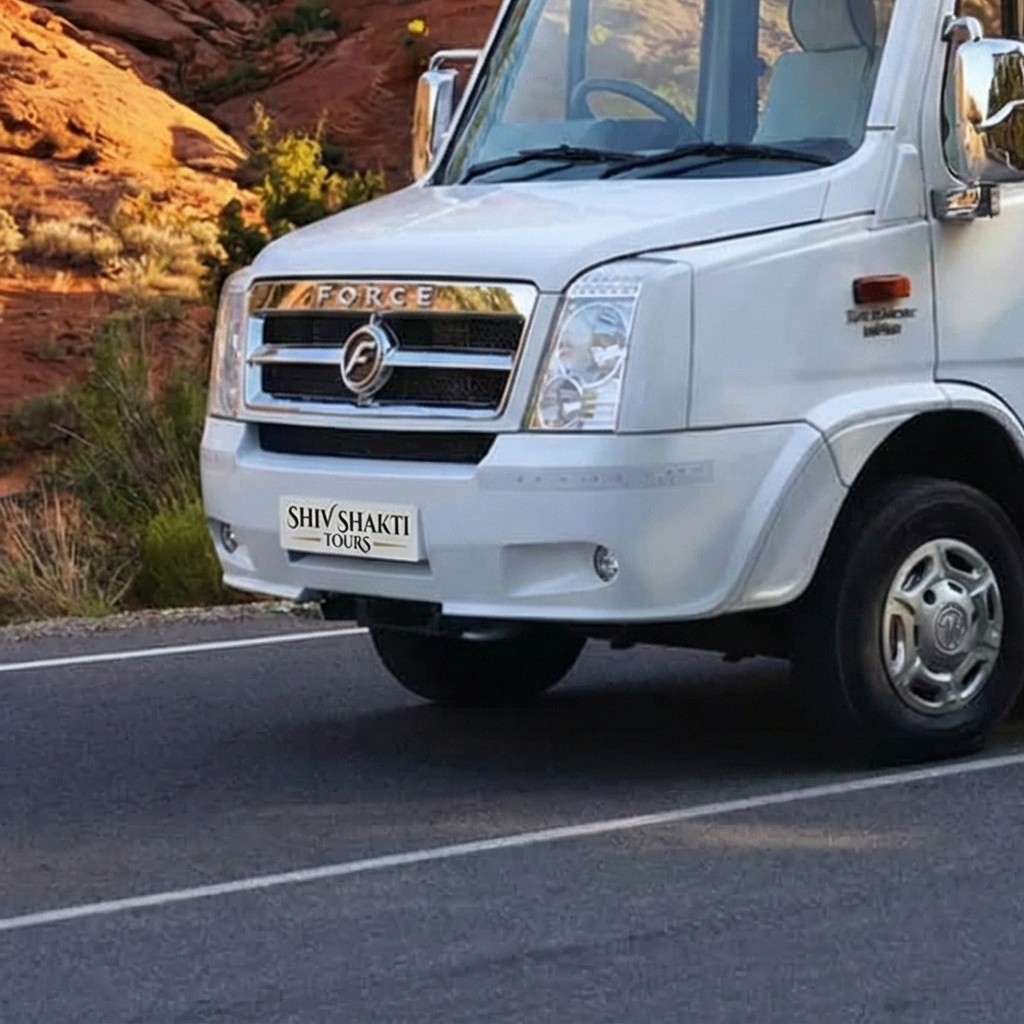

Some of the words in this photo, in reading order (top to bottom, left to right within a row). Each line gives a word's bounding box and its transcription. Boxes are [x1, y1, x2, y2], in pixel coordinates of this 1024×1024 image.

[316, 284, 435, 307] FORCE
[287, 503, 338, 529] SHIV
[337, 510, 410, 536] SHAKTI
[323, 532, 371, 554] TOURS
